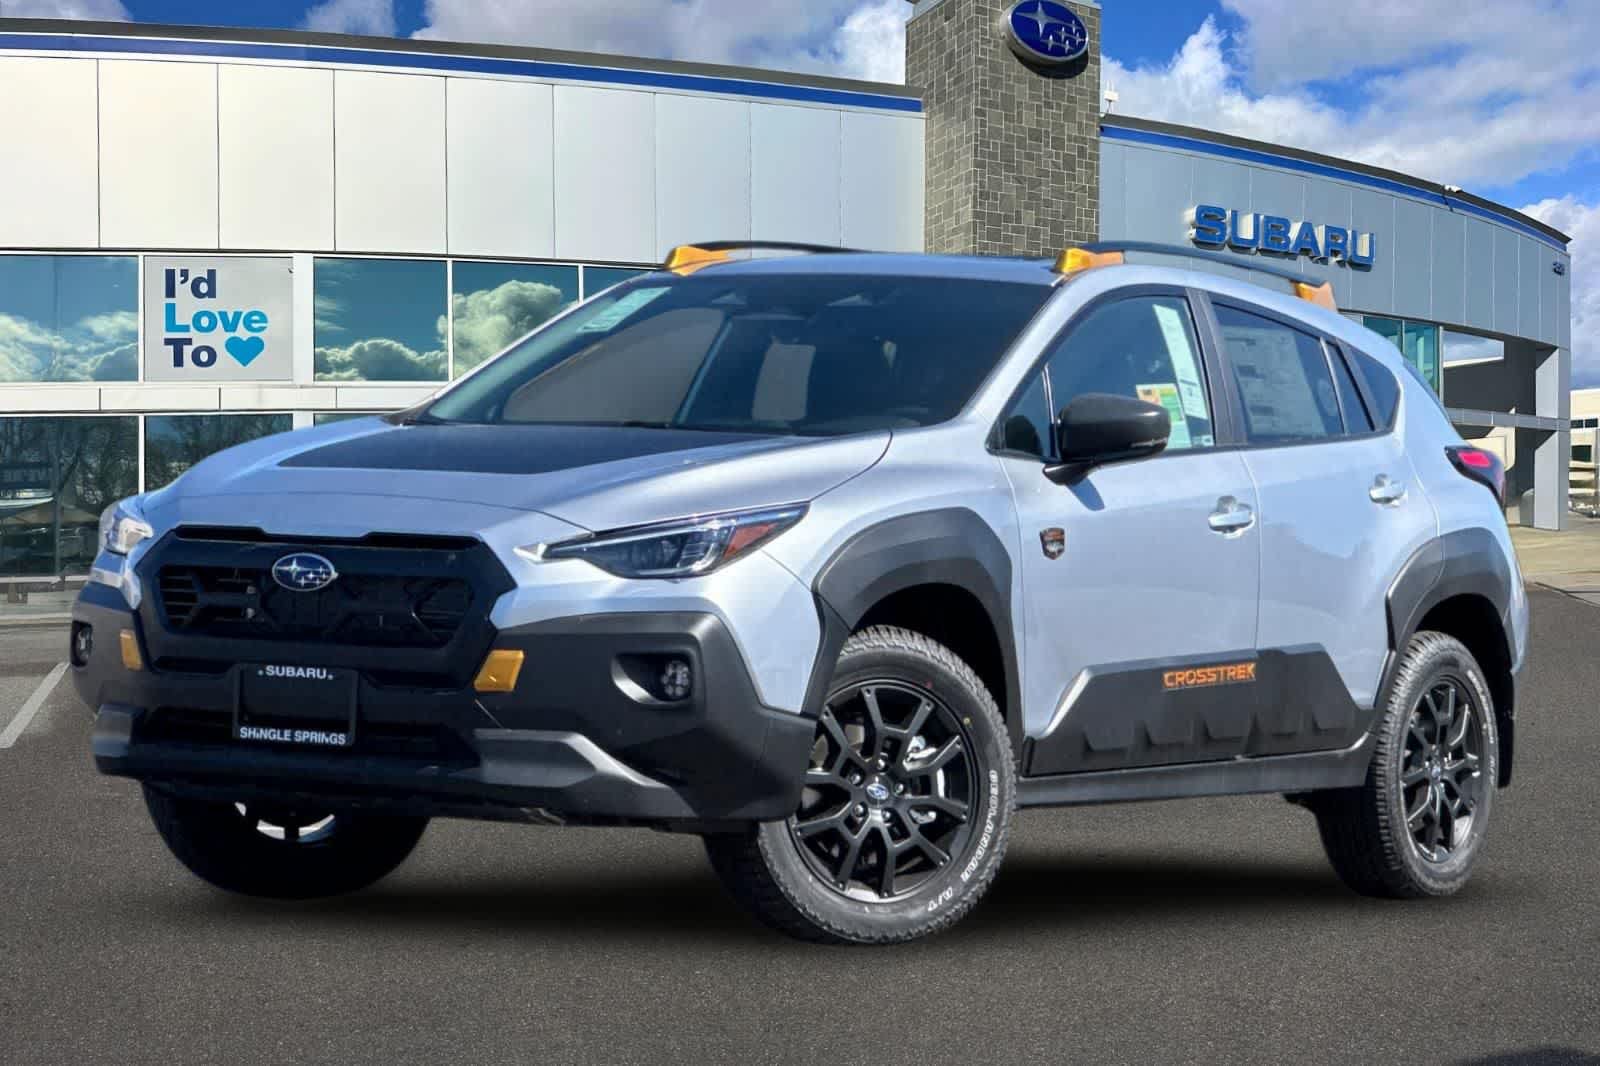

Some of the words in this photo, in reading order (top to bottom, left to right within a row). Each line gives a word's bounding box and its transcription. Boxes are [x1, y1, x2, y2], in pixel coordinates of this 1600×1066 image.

[1191, 204, 1375, 266] SUBARU
[165, 268, 217, 299] I’d
[165, 302, 268, 333] Love
[163, 337, 217, 368] To
[265, 665, 327, 680] SUBARU
[1162, 662, 1256, 688] CROSSTREK
[239, 726, 292, 742] SHINGLE
[294, 730, 346, 745] SPRINGS
